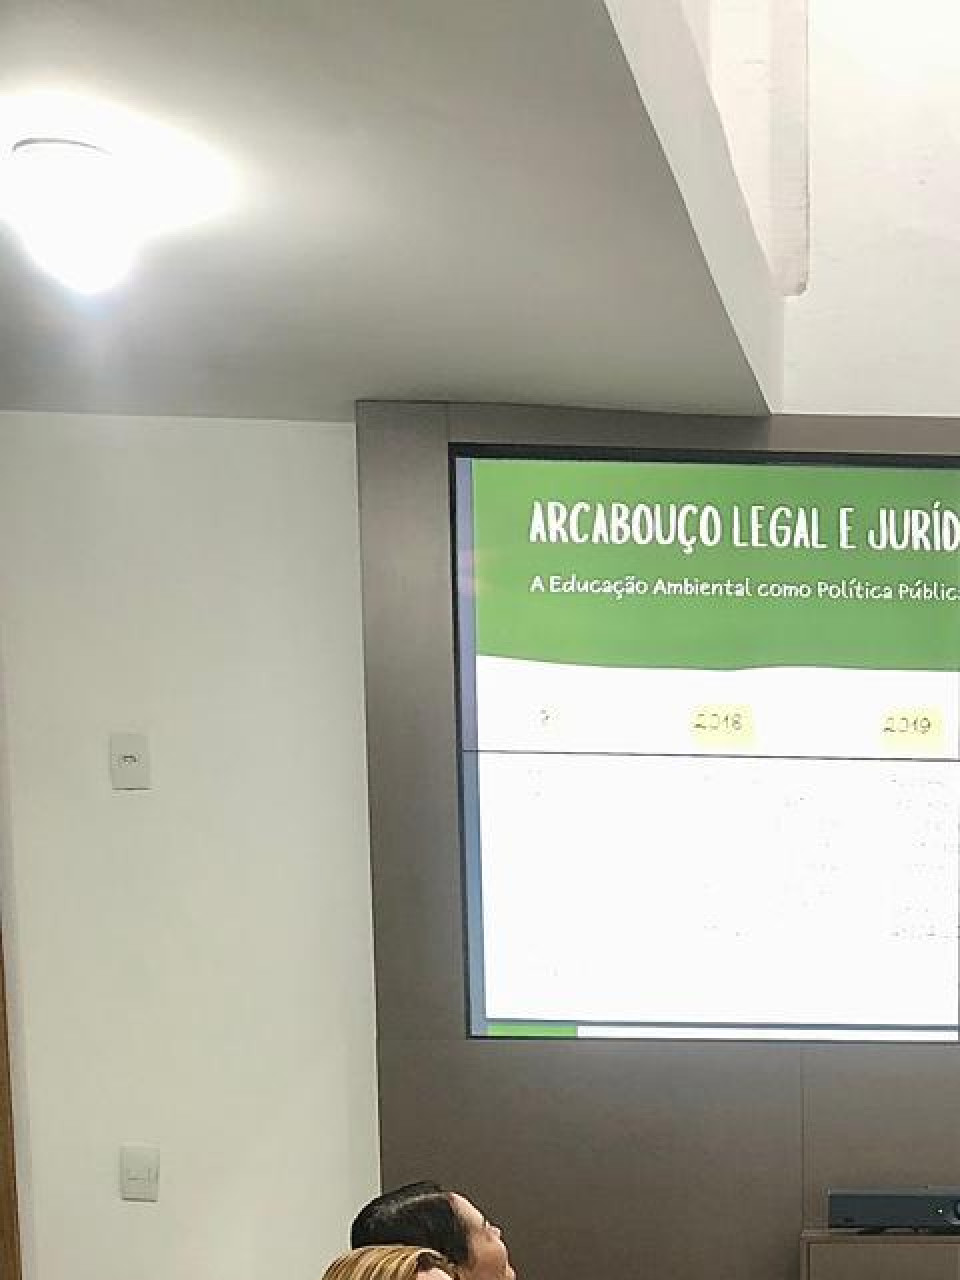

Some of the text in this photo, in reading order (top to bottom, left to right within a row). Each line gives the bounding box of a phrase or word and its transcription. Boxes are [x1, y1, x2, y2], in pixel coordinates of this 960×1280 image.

[529, 500, 722, 554] ARCABOUÇO
[732, 505, 828, 549] LEGAL
[839, 507, 857, 549] E
[530, 575, 545, 592] A
[549, 573, 648, 600] Educação
[653, 577, 752, 597] Ambiental
[757, 583, 811, 598] como
[817, 578, 893, 599] Política
[693, 713, 742, 731] 2018
[883, 717, 931, 734] 2019
